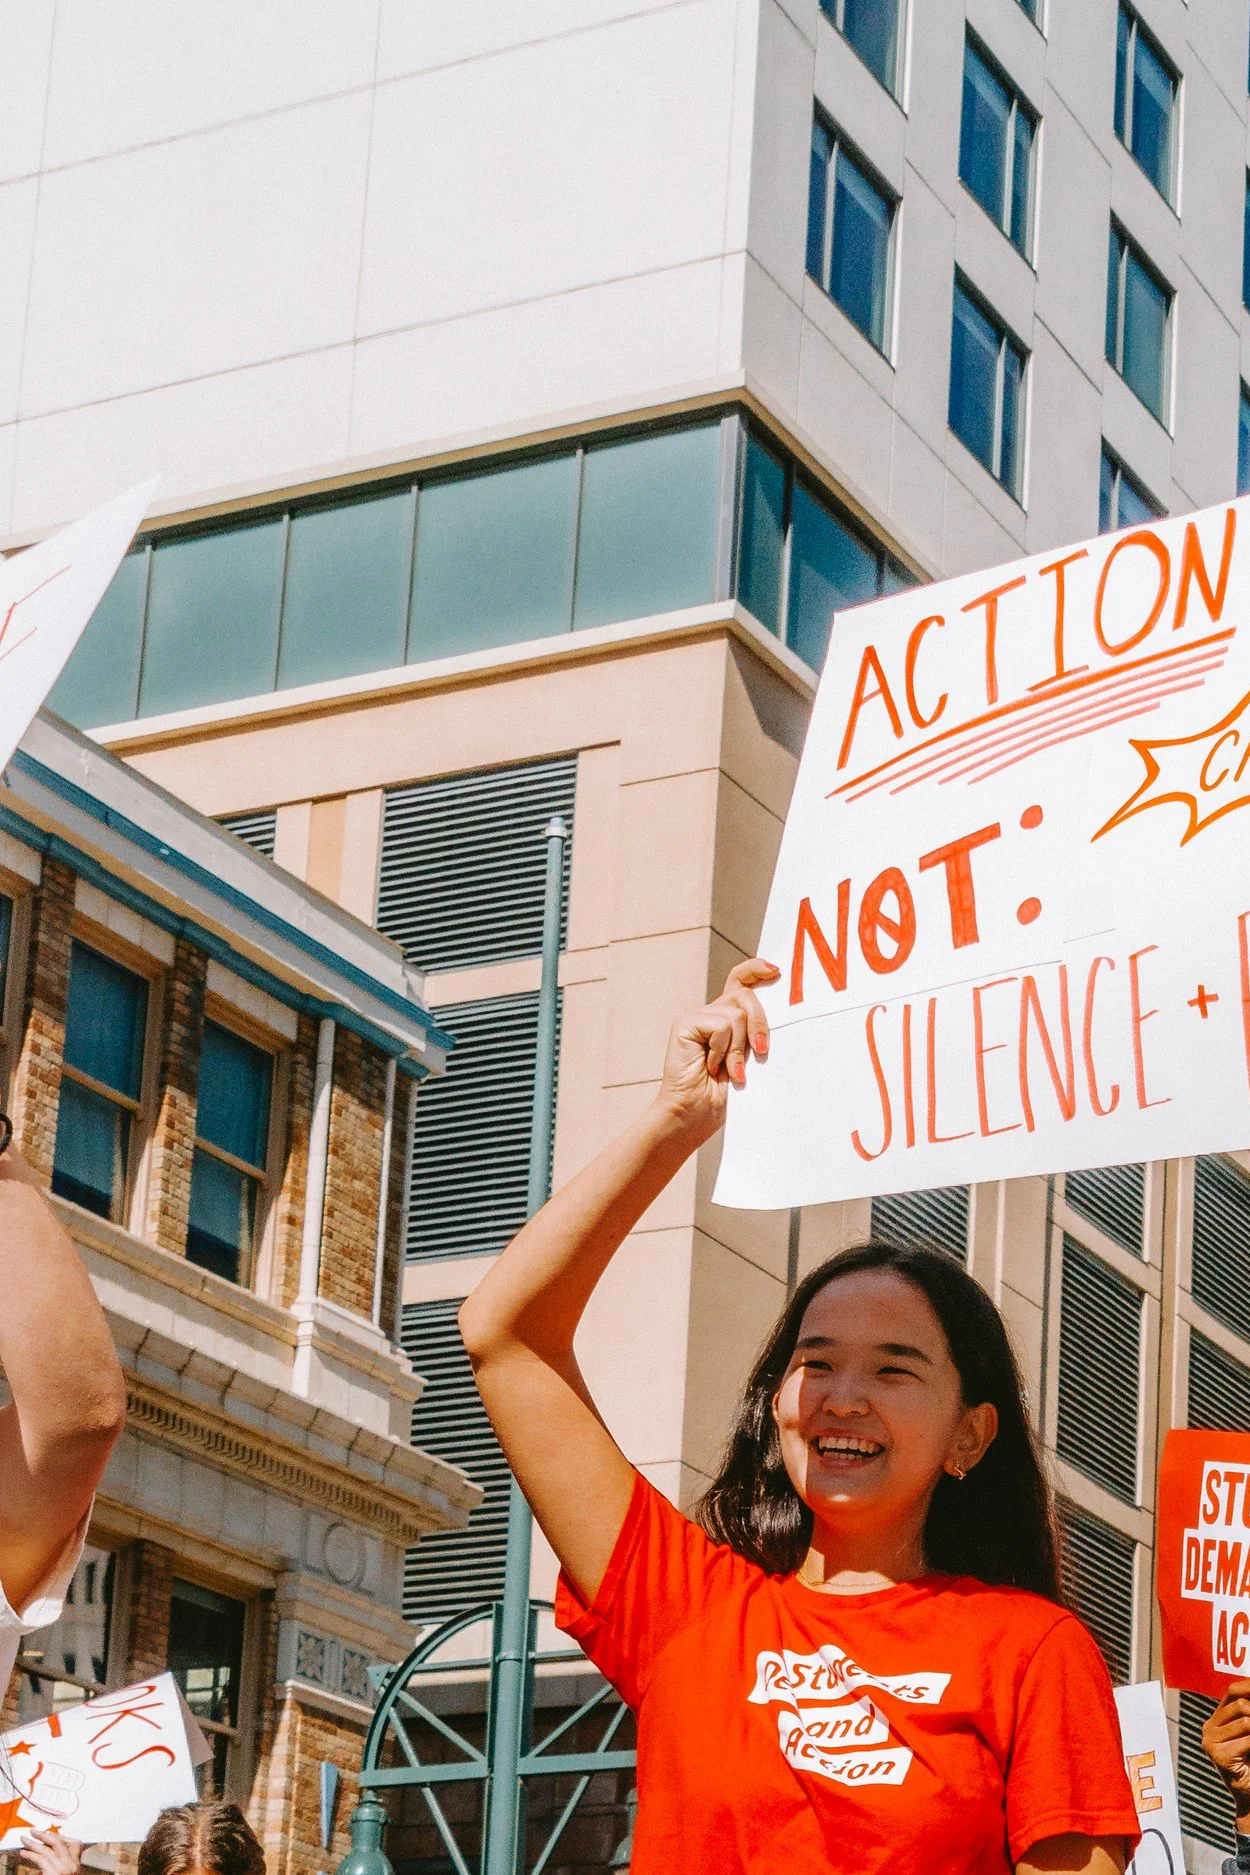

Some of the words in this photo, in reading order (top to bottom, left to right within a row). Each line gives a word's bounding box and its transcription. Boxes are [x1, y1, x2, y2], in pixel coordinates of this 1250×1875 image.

[837, 507, 1238, 771] ACTION
[788, 804, 1045, 1008] NOT:
[850, 946, 1175, 1162] SILENCE
